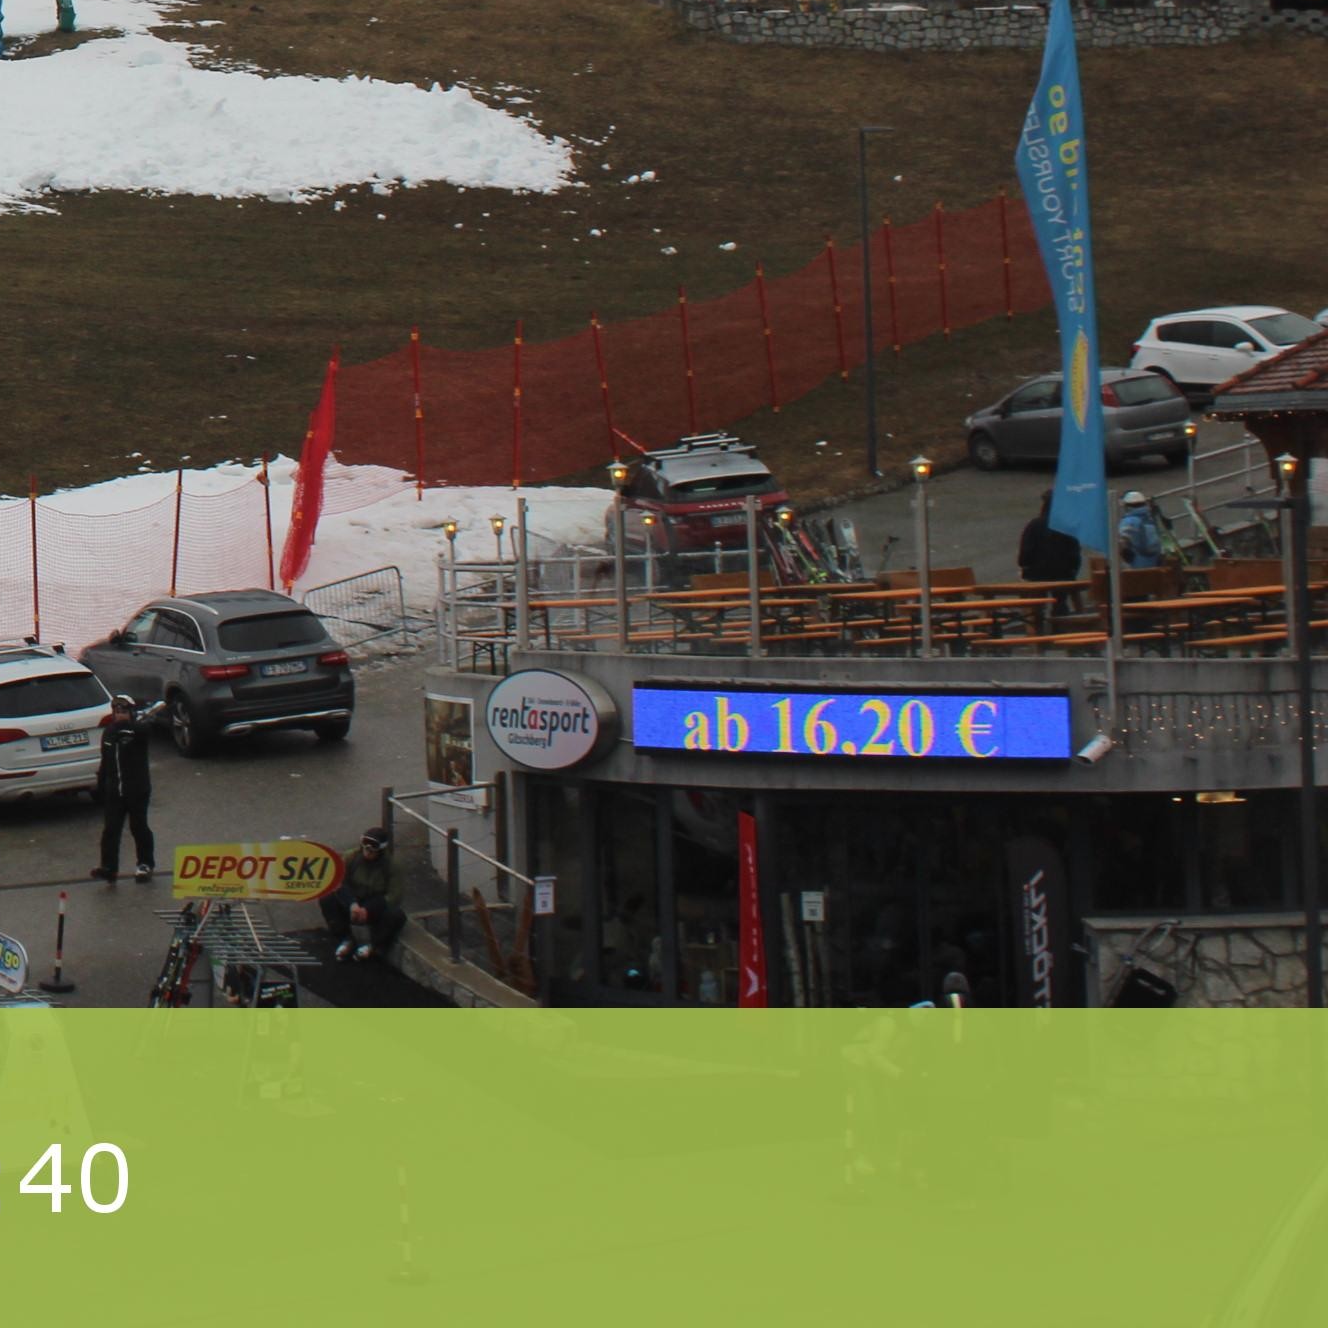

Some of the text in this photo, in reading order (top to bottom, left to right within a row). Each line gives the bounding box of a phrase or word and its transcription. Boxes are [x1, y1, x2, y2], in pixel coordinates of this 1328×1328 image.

[492, 696, 590, 747] rentasport
[684, 696, 750, 752] ab
[955, 699, 999, 758] €
[179, 855, 330, 881] DEPOT SKI
[285, 881, 322, 890] SERVICE
[5, 950, 20, 969] go
